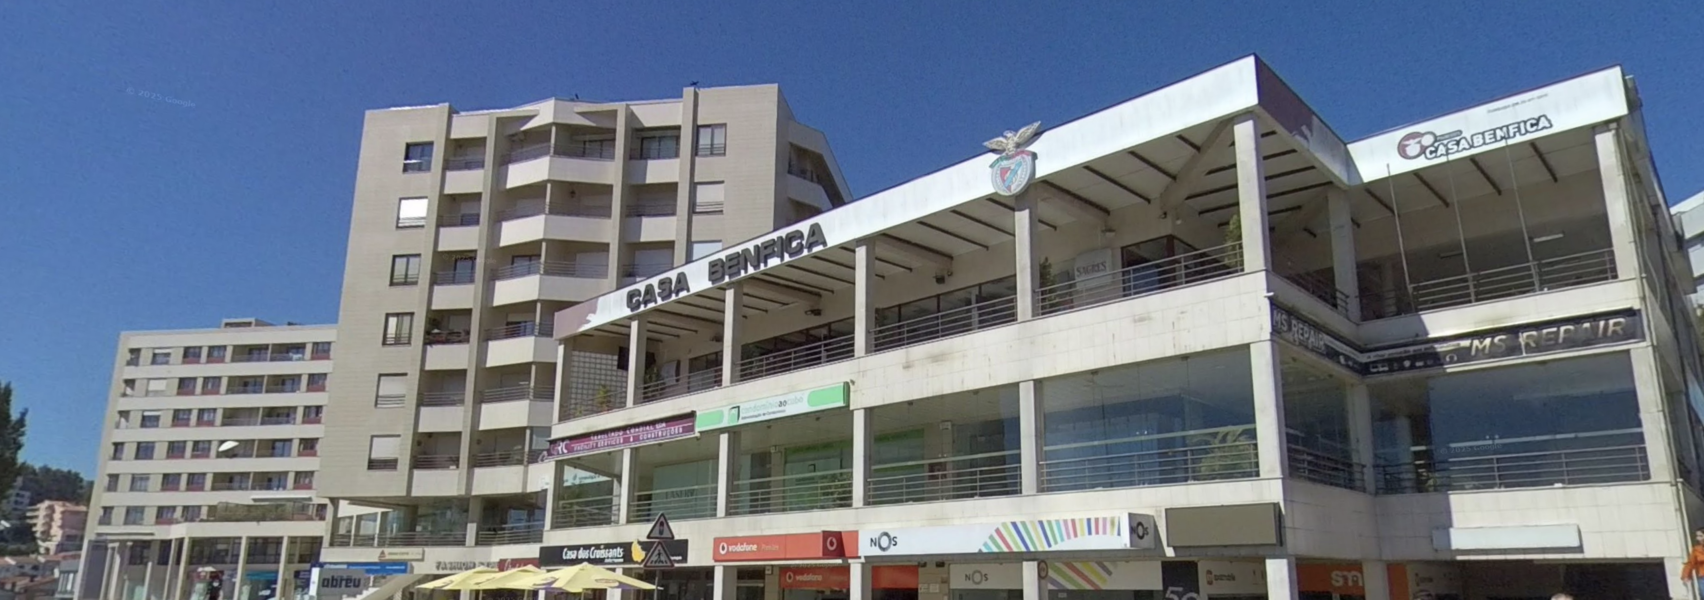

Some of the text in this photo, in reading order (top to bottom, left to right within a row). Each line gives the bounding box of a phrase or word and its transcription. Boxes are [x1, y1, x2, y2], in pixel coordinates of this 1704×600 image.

[1424, 114, 1553, 160] CASA BENFICA
[626, 222, 827, 312] CASA BENFICA
[1273, 309, 1289, 331] MS
[1291, 317, 1325, 350] REPAIR
[1471, 317, 1626, 356] MS REPAIR
[1131, 521, 1149, 540] NOS
[728, 542, 757, 553] vodafone
[870, 531, 898, 552] NOS
[563, 545, 624, 559] Casa dos Croissants
[321, 574, 361, 588] abreu
[795, 572, 822, 582] vodafone
[965, 570, 988, 585] NOS
